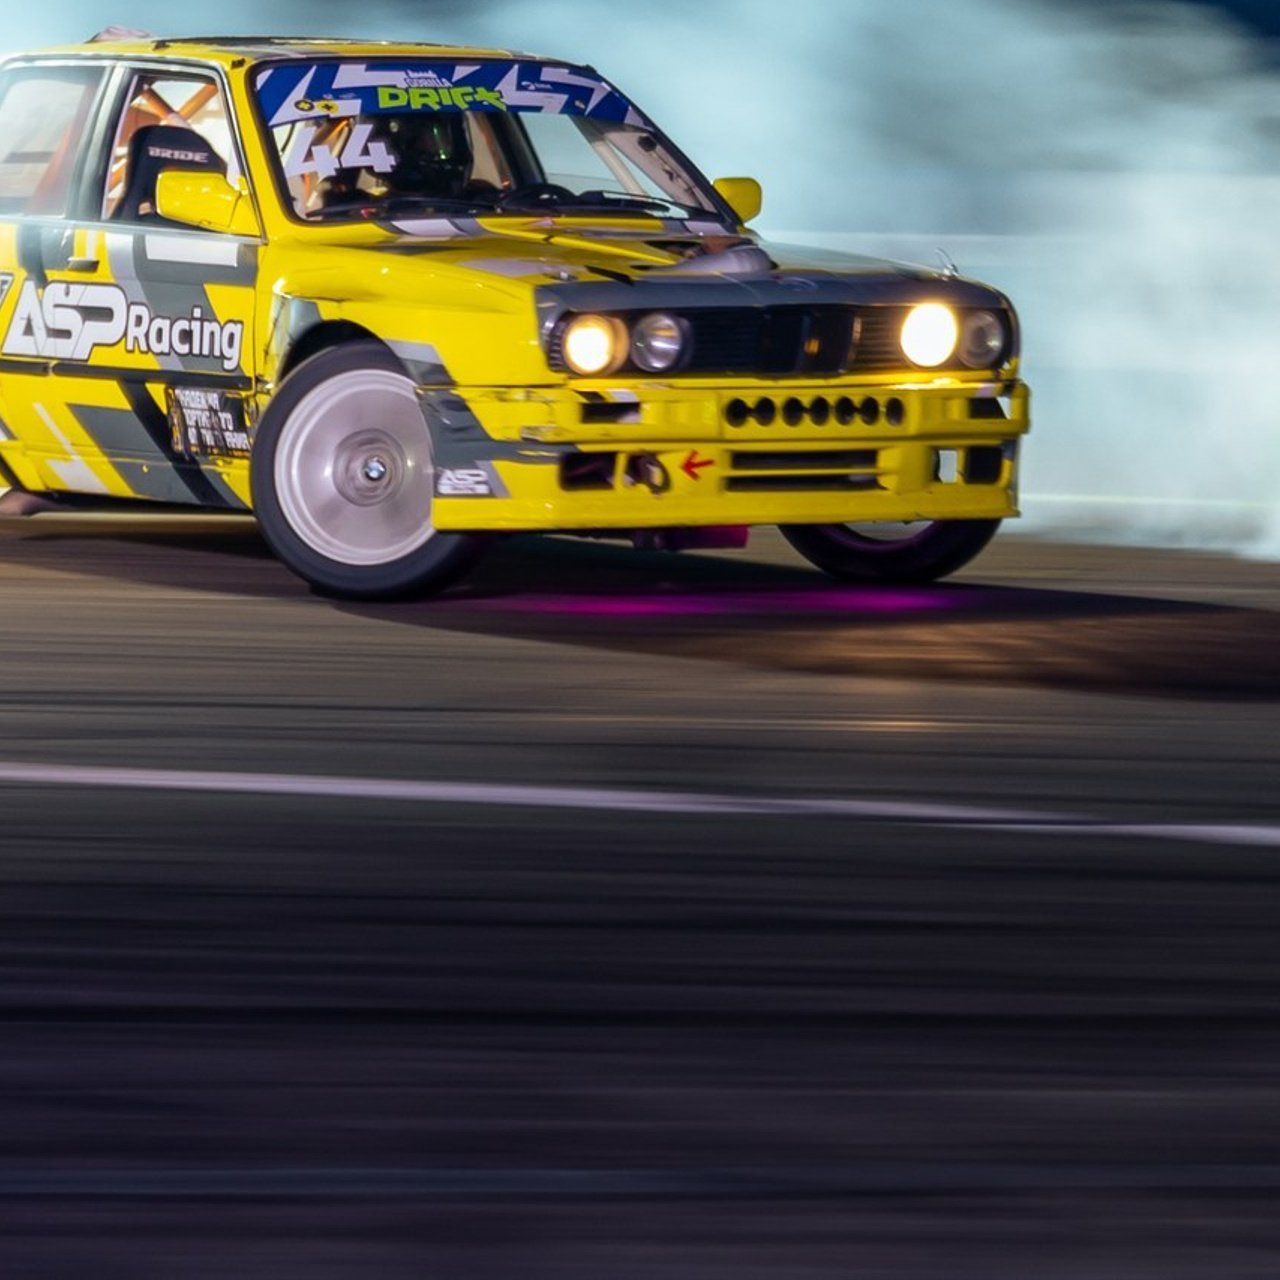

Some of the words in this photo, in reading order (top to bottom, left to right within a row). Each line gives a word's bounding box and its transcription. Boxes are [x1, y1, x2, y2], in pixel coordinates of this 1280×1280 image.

[148, 146, 208, 163] BRIDE
[284, 123, 396, 179] 44
[1, 281, 126, 360] ASP
[126, 303, 243, 370] Racing
